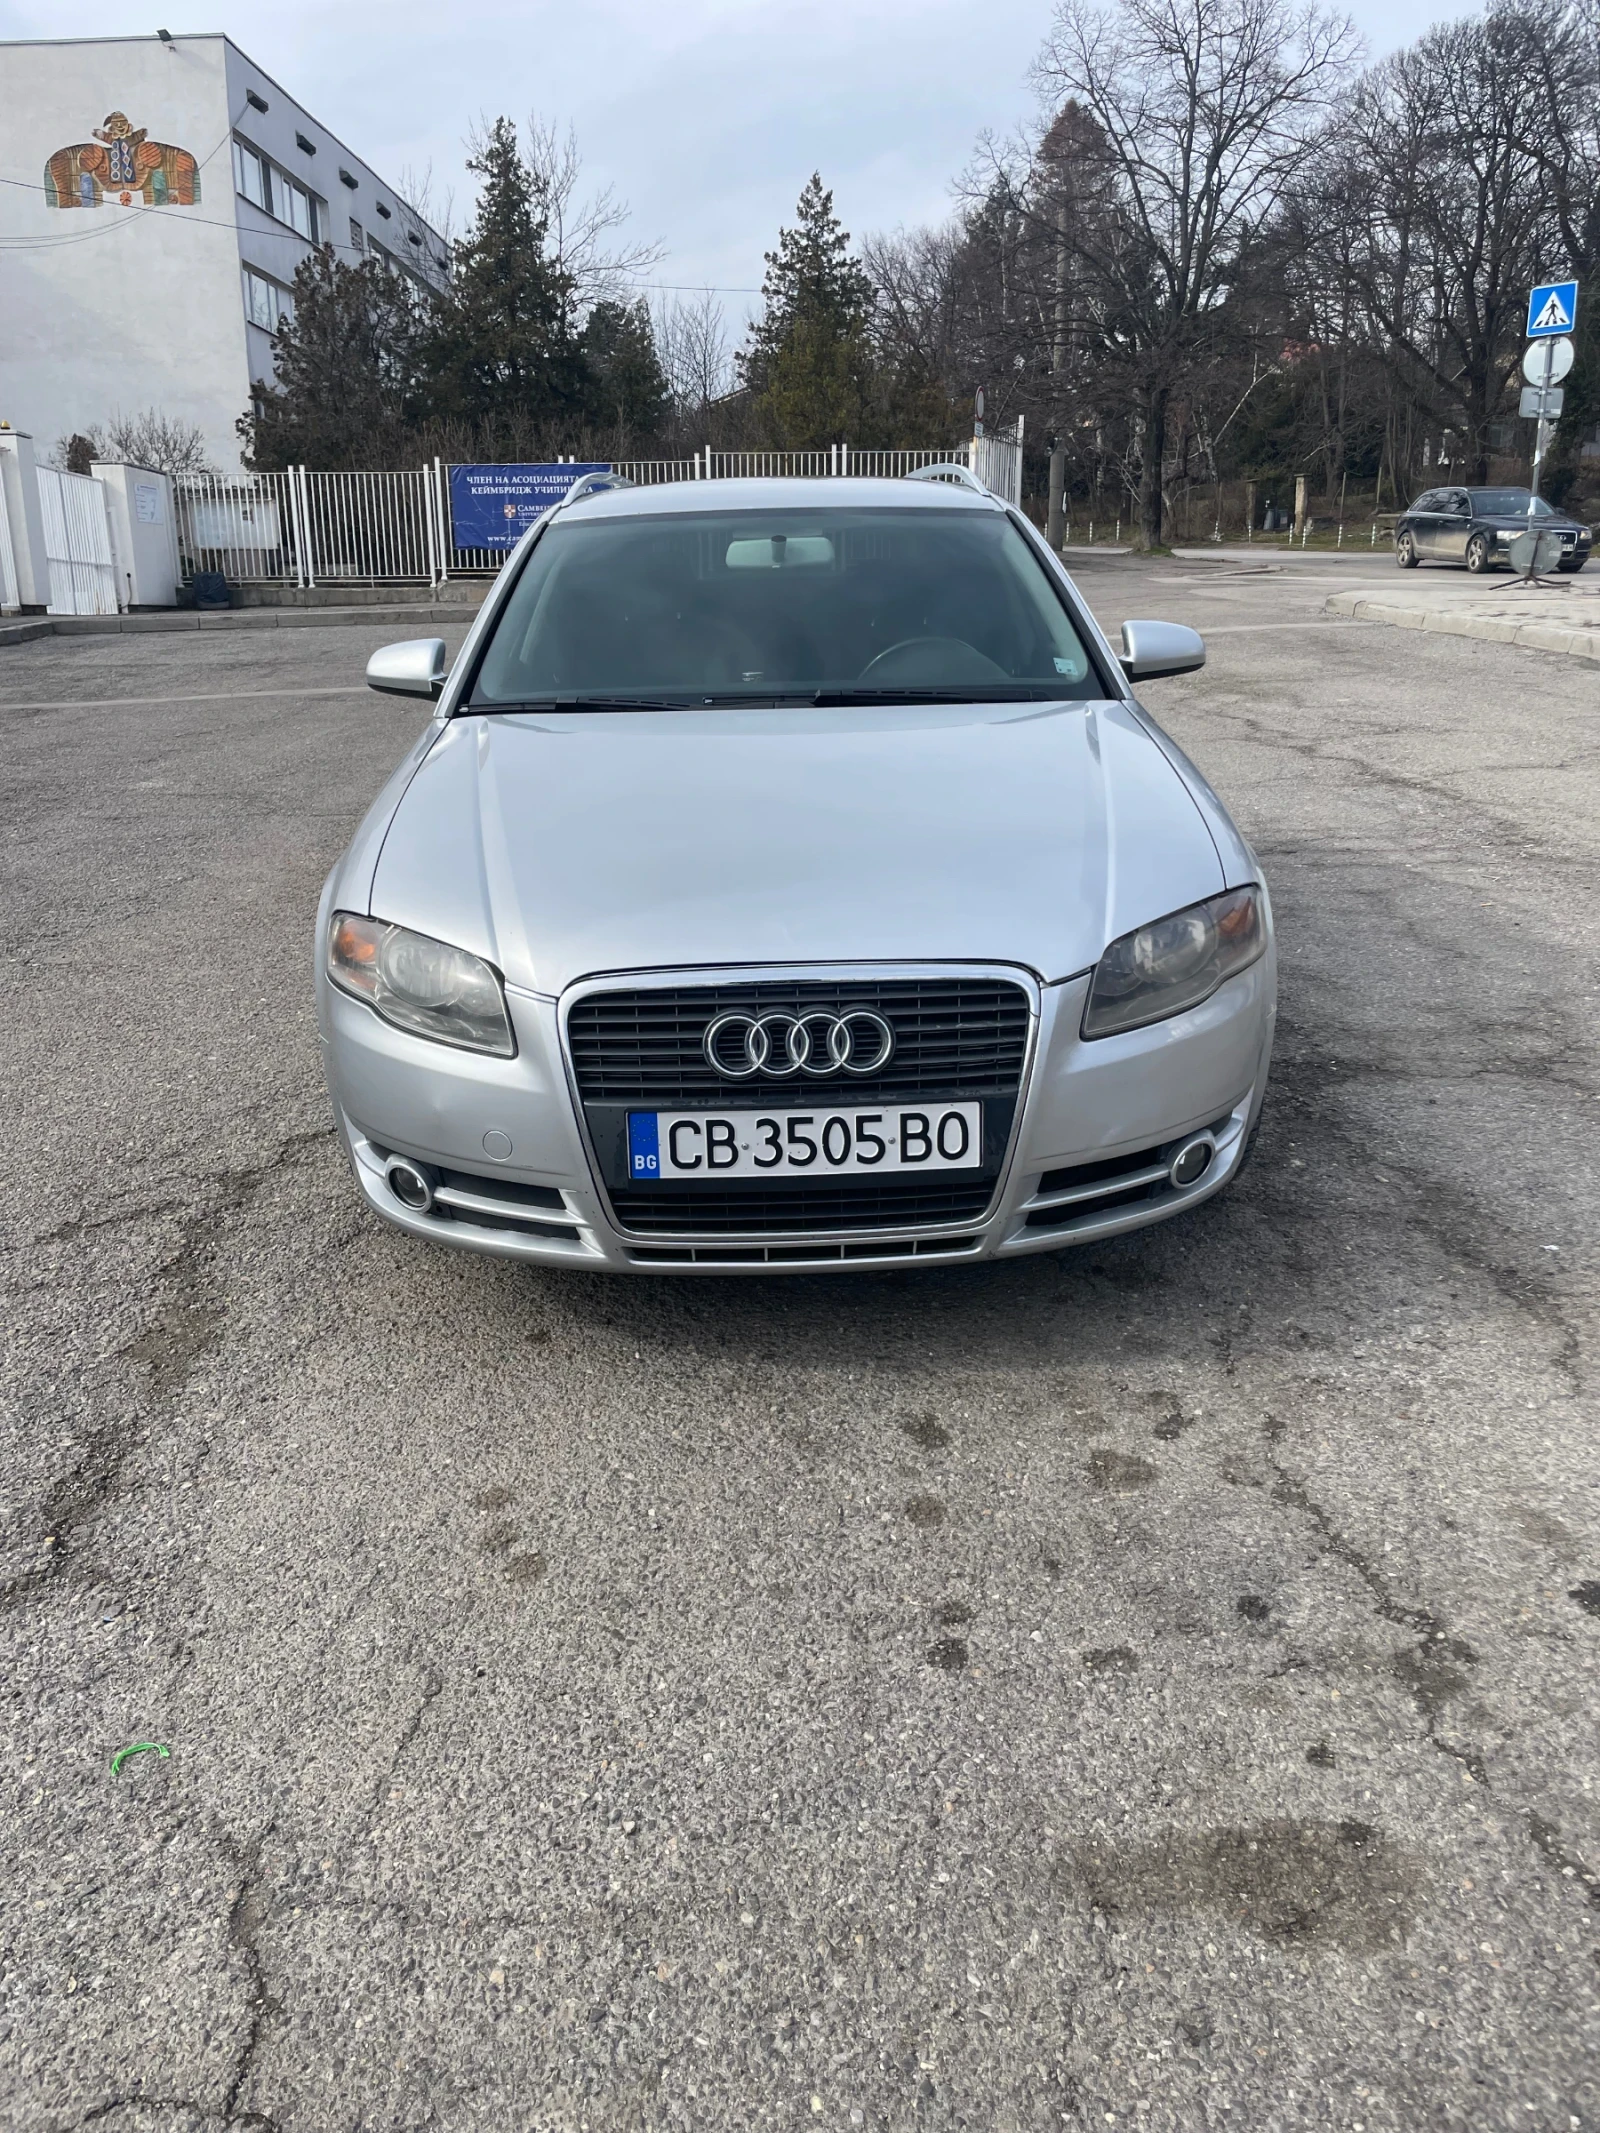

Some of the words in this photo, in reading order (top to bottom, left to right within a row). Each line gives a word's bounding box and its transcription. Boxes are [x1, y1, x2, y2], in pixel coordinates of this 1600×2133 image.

[466, 476, 493, 484] ЧЛЕН
[495, 476, 509, 484] НА
[471, 485, 532, 495] КЕЙМБРИДЖ
[517, 504, 550, 512] CAMBRI
[668, 1119, 739, 1169] CB
[753, 1114, 887, 1168] 3505
[899, 1110, 969, 1163] BO
[634, 1154, 657, 1171] BG
